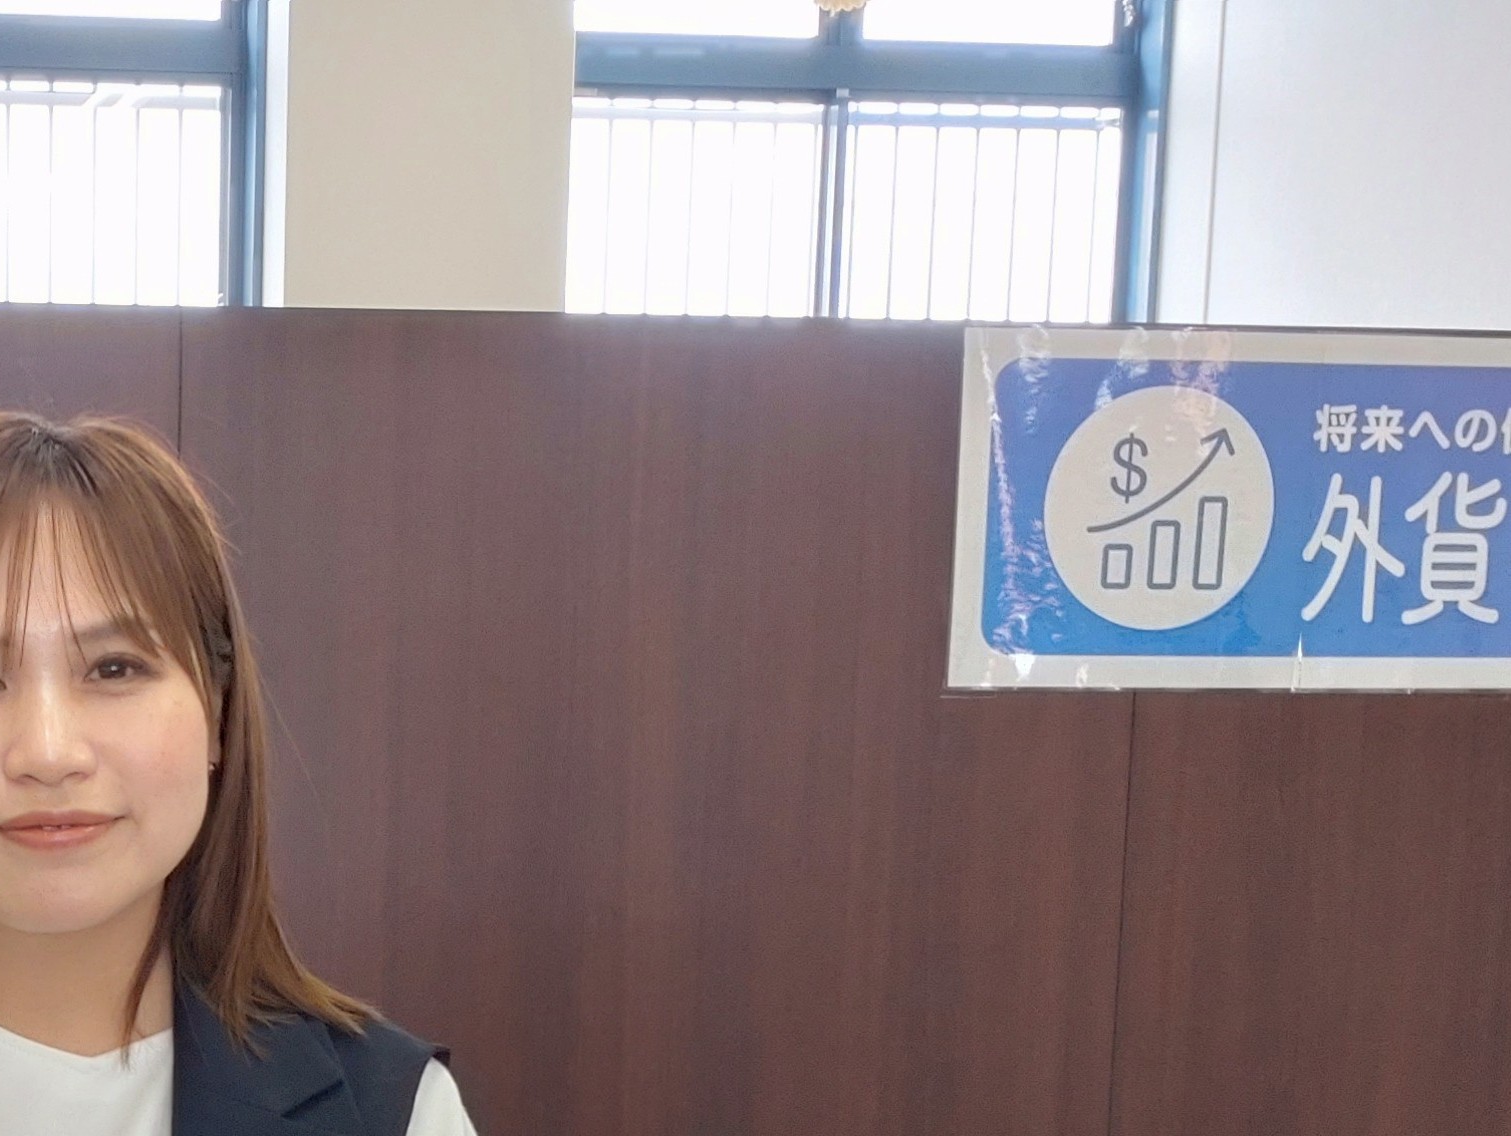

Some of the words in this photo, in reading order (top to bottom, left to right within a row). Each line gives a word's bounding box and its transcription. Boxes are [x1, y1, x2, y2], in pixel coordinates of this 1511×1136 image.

[1313, 403, 1511, 455] 将来への
[1109, 432, 1149, 503] $
[1300, 471, 1508, 626] 外貨
